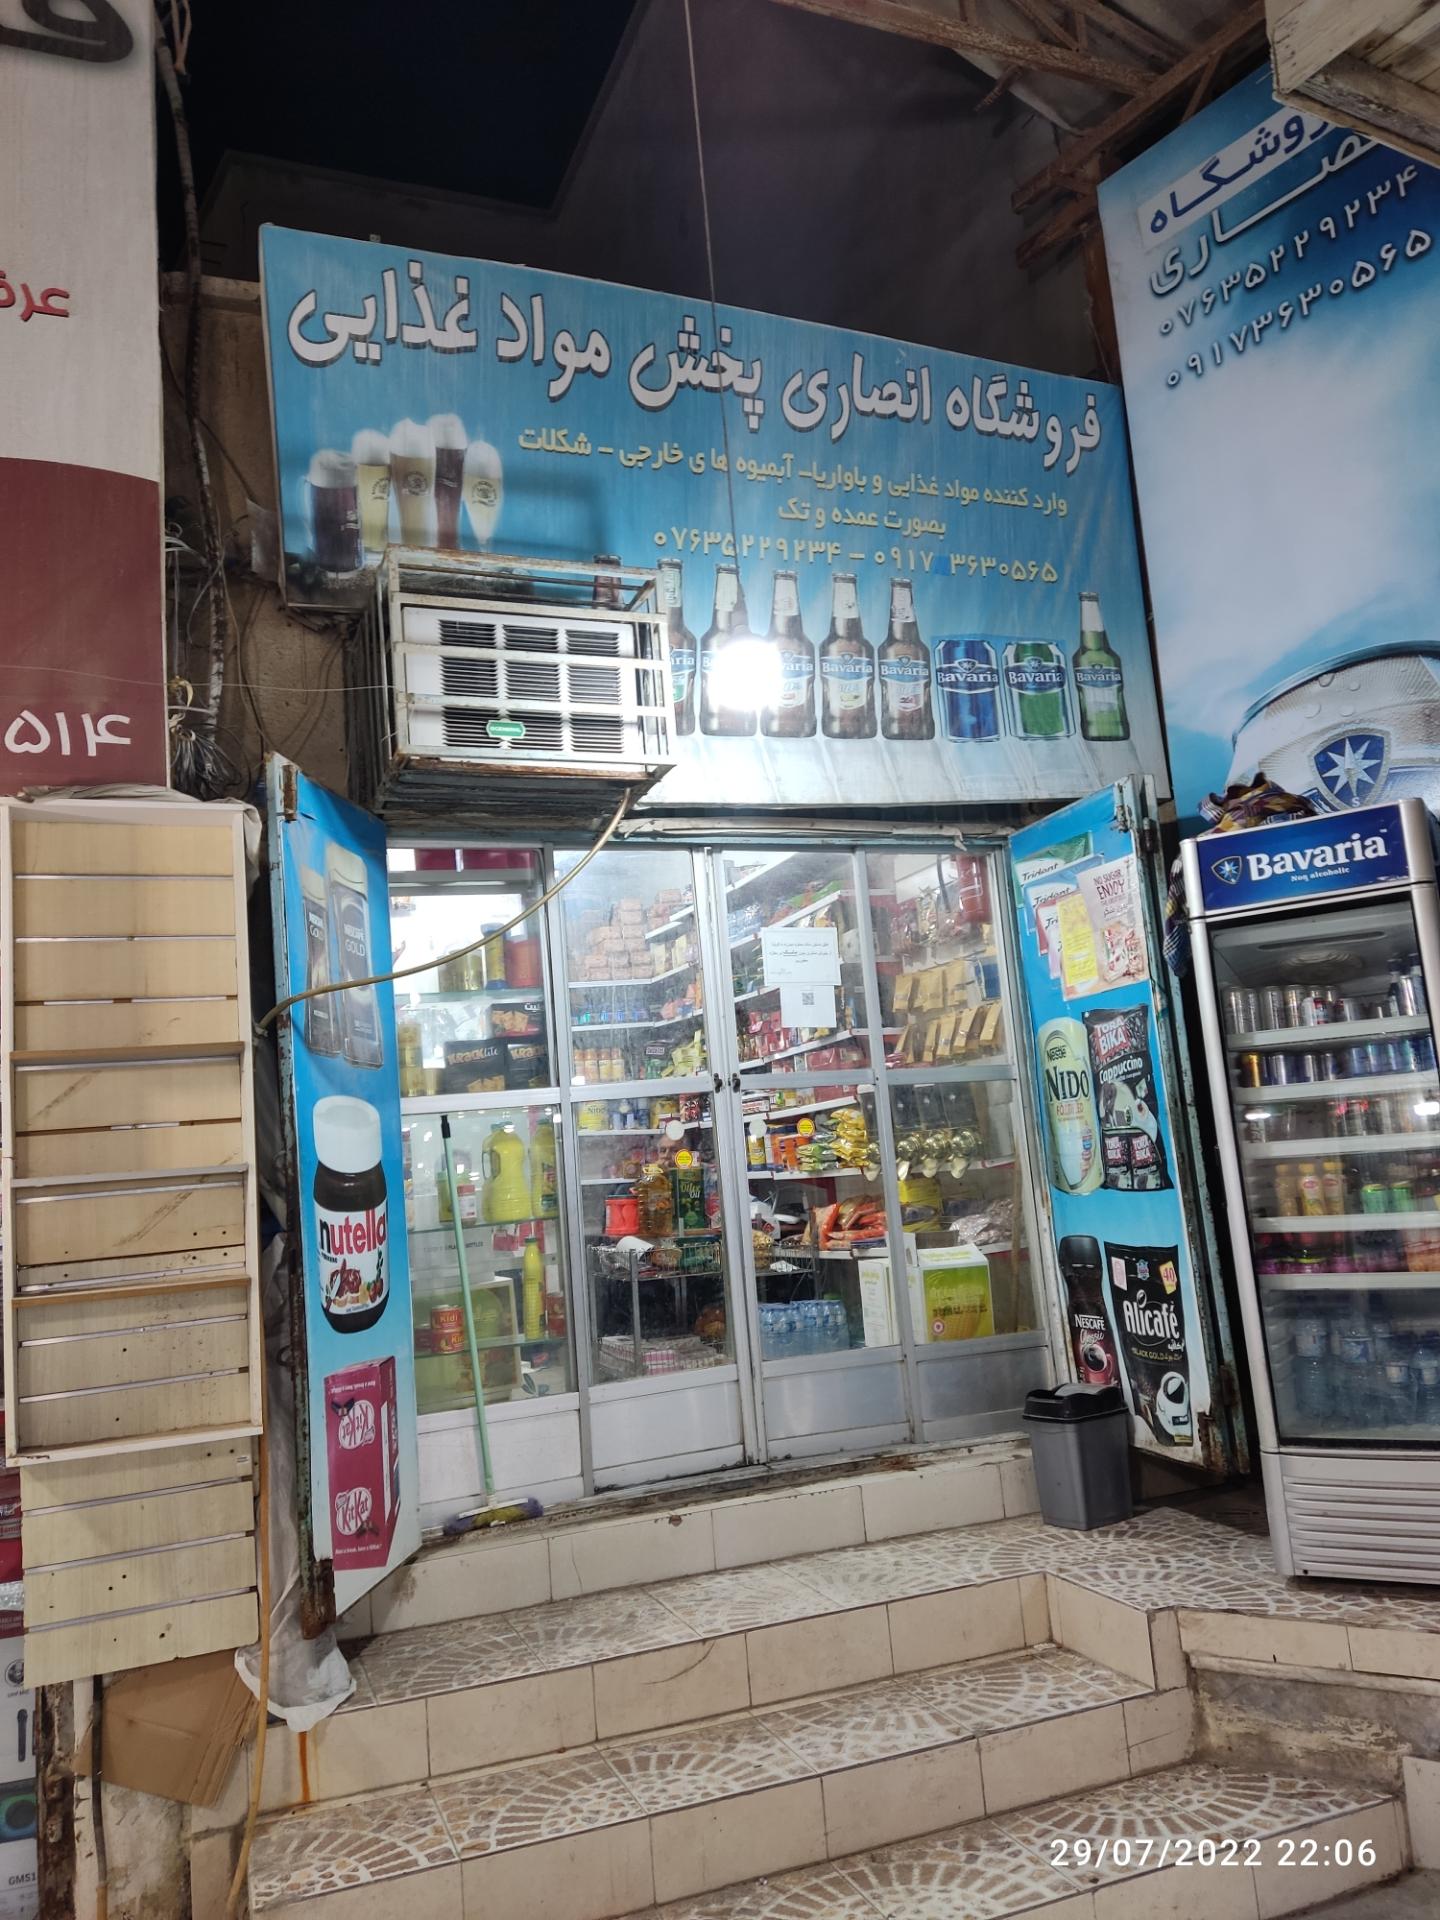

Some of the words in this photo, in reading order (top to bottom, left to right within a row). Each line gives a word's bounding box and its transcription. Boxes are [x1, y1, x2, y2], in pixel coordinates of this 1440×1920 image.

[1149, 115, 1328, 233] روشگاه
[1150, 133, 1378, 296] صاری
[287, 260, 479, 367] غذایی
[1166, 229, 1433, 387] ۰۹۱۷۳۶۳۰۵۶۵
[496, 292, 612, 402] مواد
[628, 314, 765, 433] پخش
[780, 351, 932, 443] انصاری
[945, 369, 1102, 475] فروشگاه
[518, 427, 592, 456] شکلات
[619, 442, 684, 469] خارجی
[736, 452, 794, 484] آبمیوه
[872, 474, 882, 494] و
[888, 473, 939, 497] غذایی
[944, 479, 979, 506] مواد
[983, 487, 1029, 508] کننده
[778, 497, 811, 521] تک
[832, 507, 879, 528] عمده
[1033, 491, 1068, 517] وارد
[815, 507, 826, 529] و
[884, 509, 947, 540] بصورت
[822, 662, 873, 673] Bavaria
[880, 665, 929, 676] Bavaria
[937, 670, 998, 683] Bavaria
[1008, 670, 1063, 684] Bavaria
[1077, 671, 1122, 682] Bavaria
[1247, 833, 1389, 882] Bavaria
[1310, 866, 1350, 880] alcoholic
[1096, 879, 1125, 900] ENJOY
[1099, 1027, 1127, 1056] BIKA
[1099, 1056, 1143, 1084] Cappuccino
[1045, 1066, 1090, 1102] NIDO
[319, 1208, 386, 1256] nutella
